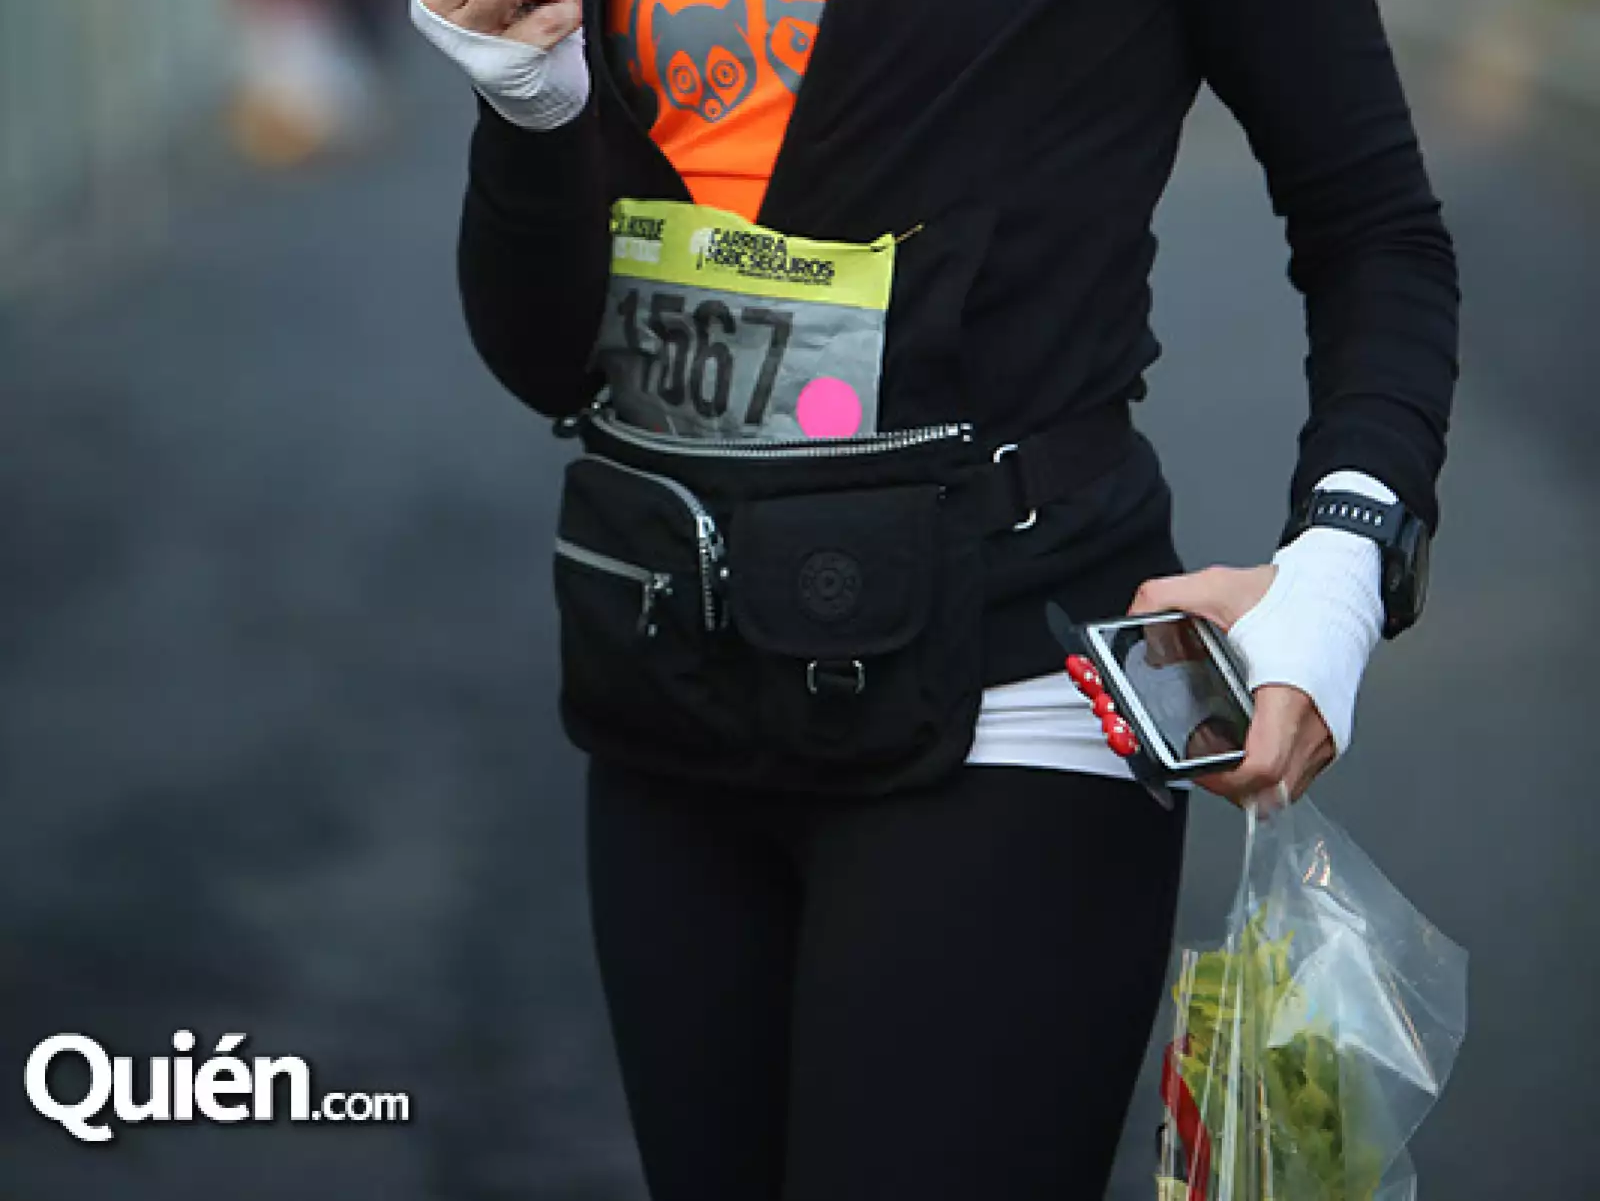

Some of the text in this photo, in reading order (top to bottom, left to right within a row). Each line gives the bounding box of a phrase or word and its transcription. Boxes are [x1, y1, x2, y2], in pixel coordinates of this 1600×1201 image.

[710, 228, 788, 260] CARRERA
[748, 253, 835, 278] SEGUROS
[616, 288, 792, 426] 1567
